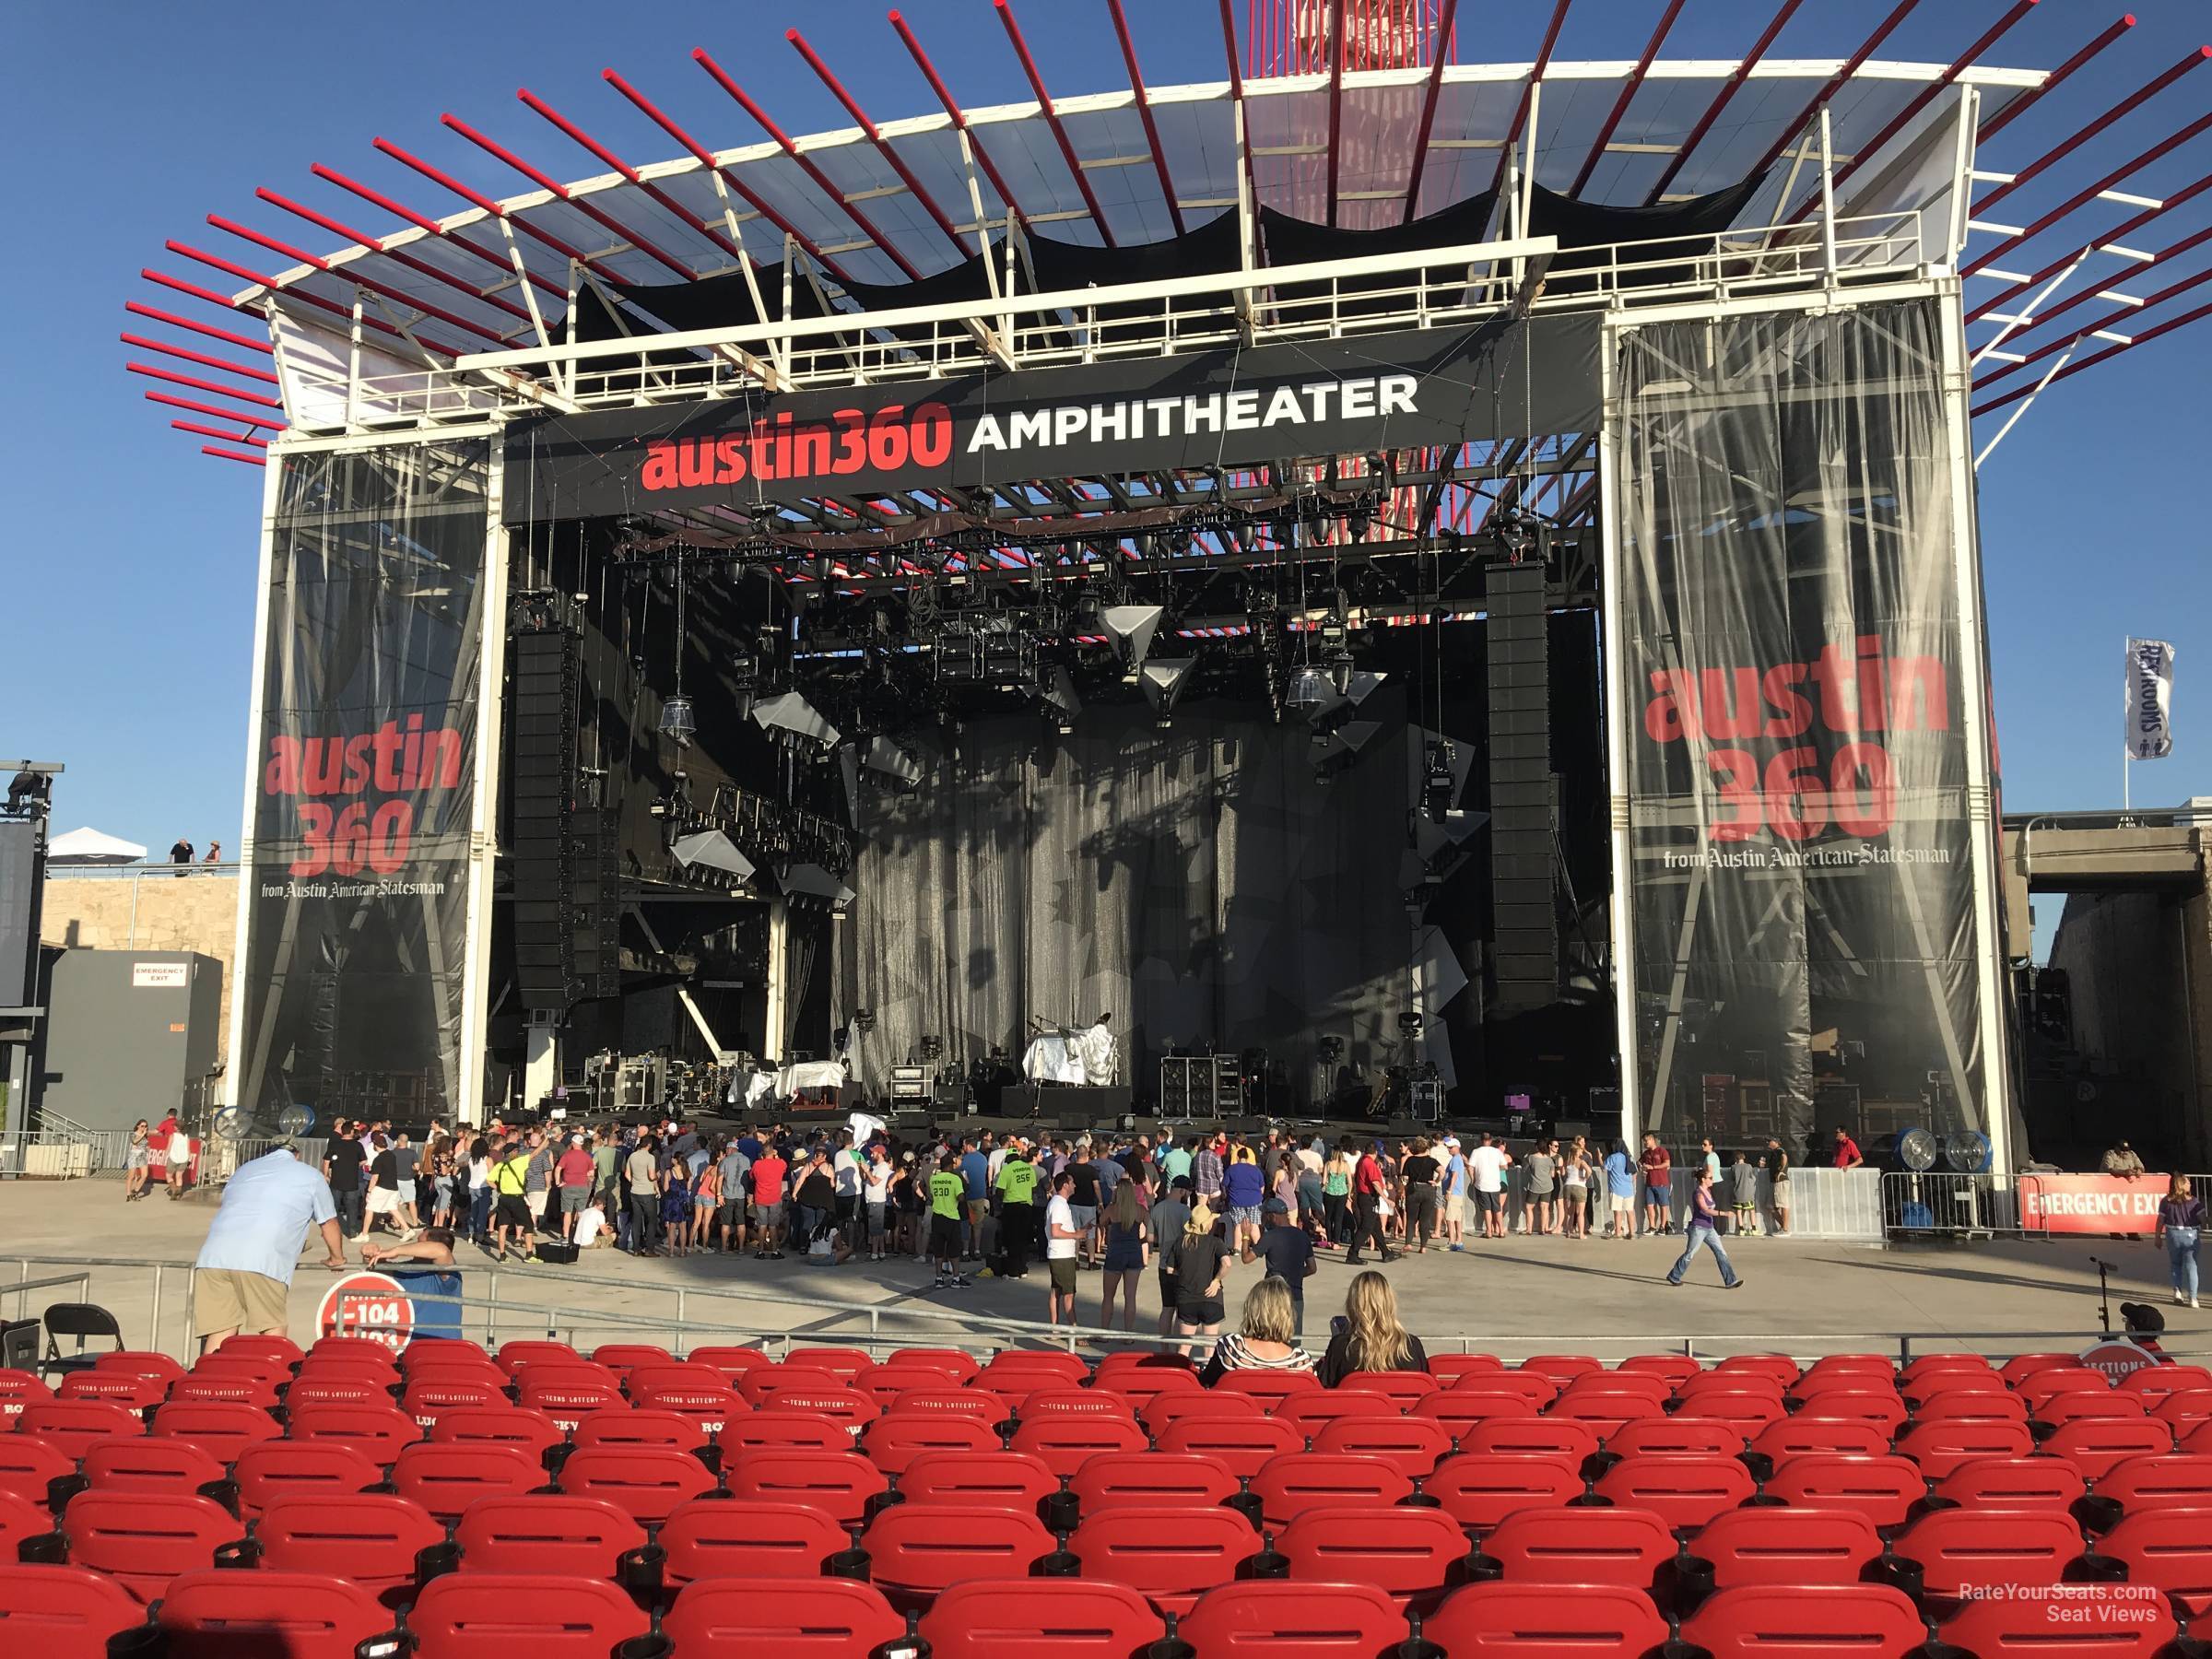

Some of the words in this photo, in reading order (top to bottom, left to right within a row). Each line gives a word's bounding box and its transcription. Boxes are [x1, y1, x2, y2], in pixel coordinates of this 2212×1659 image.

[642, 402, 952, 490] austin360
[967, 373, 1418, 453] AMPHITHEATER
[1644, 634, 1949, 743] austin
[265, 713, 461, 795] austin
[1706, 742, 1897, 841] 360
[288, 799, 413, 877] 360
[1664, 851, 1704, 868] from
[1707, 847, 1766, 869] Austin
[1768, 842, 1950, 869] American-Statesman
[262, 883, 283, 898] from
[283, 881, 326, 900] Austin
[328, 878, 444, 900] American-Statesman
[934, 1188, 949, 1196] 230
[2028, 1193, 2127, 1216] EMERGENCY
[358, 1302, 399, 1324] 104
